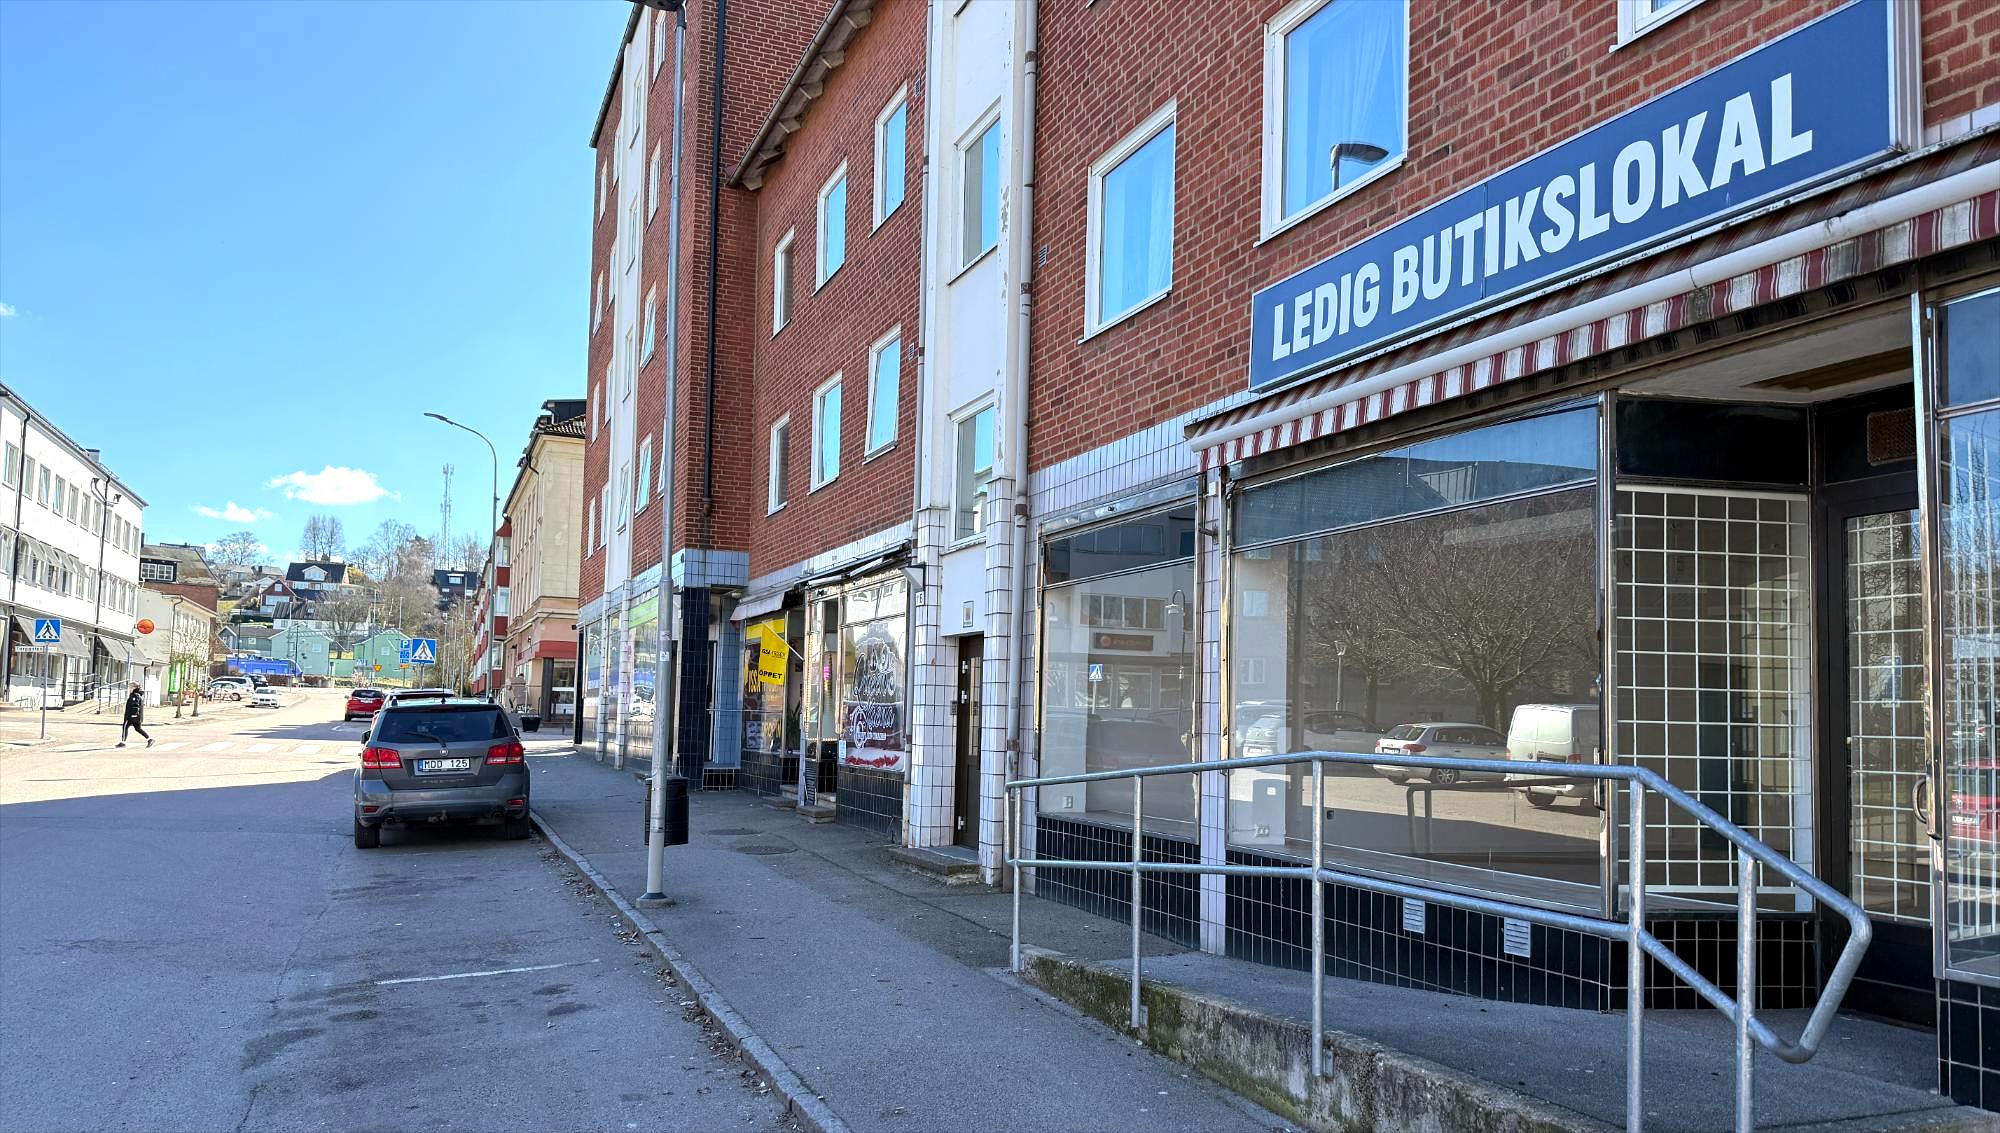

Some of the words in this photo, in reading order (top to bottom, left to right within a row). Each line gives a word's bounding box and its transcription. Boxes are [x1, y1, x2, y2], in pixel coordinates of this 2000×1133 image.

[1272, 262, 1381, 361] LEDIG
[1391, 72, 1813, 315] BUTIKSLOKAL
[450, 759, 468, 768] 125
